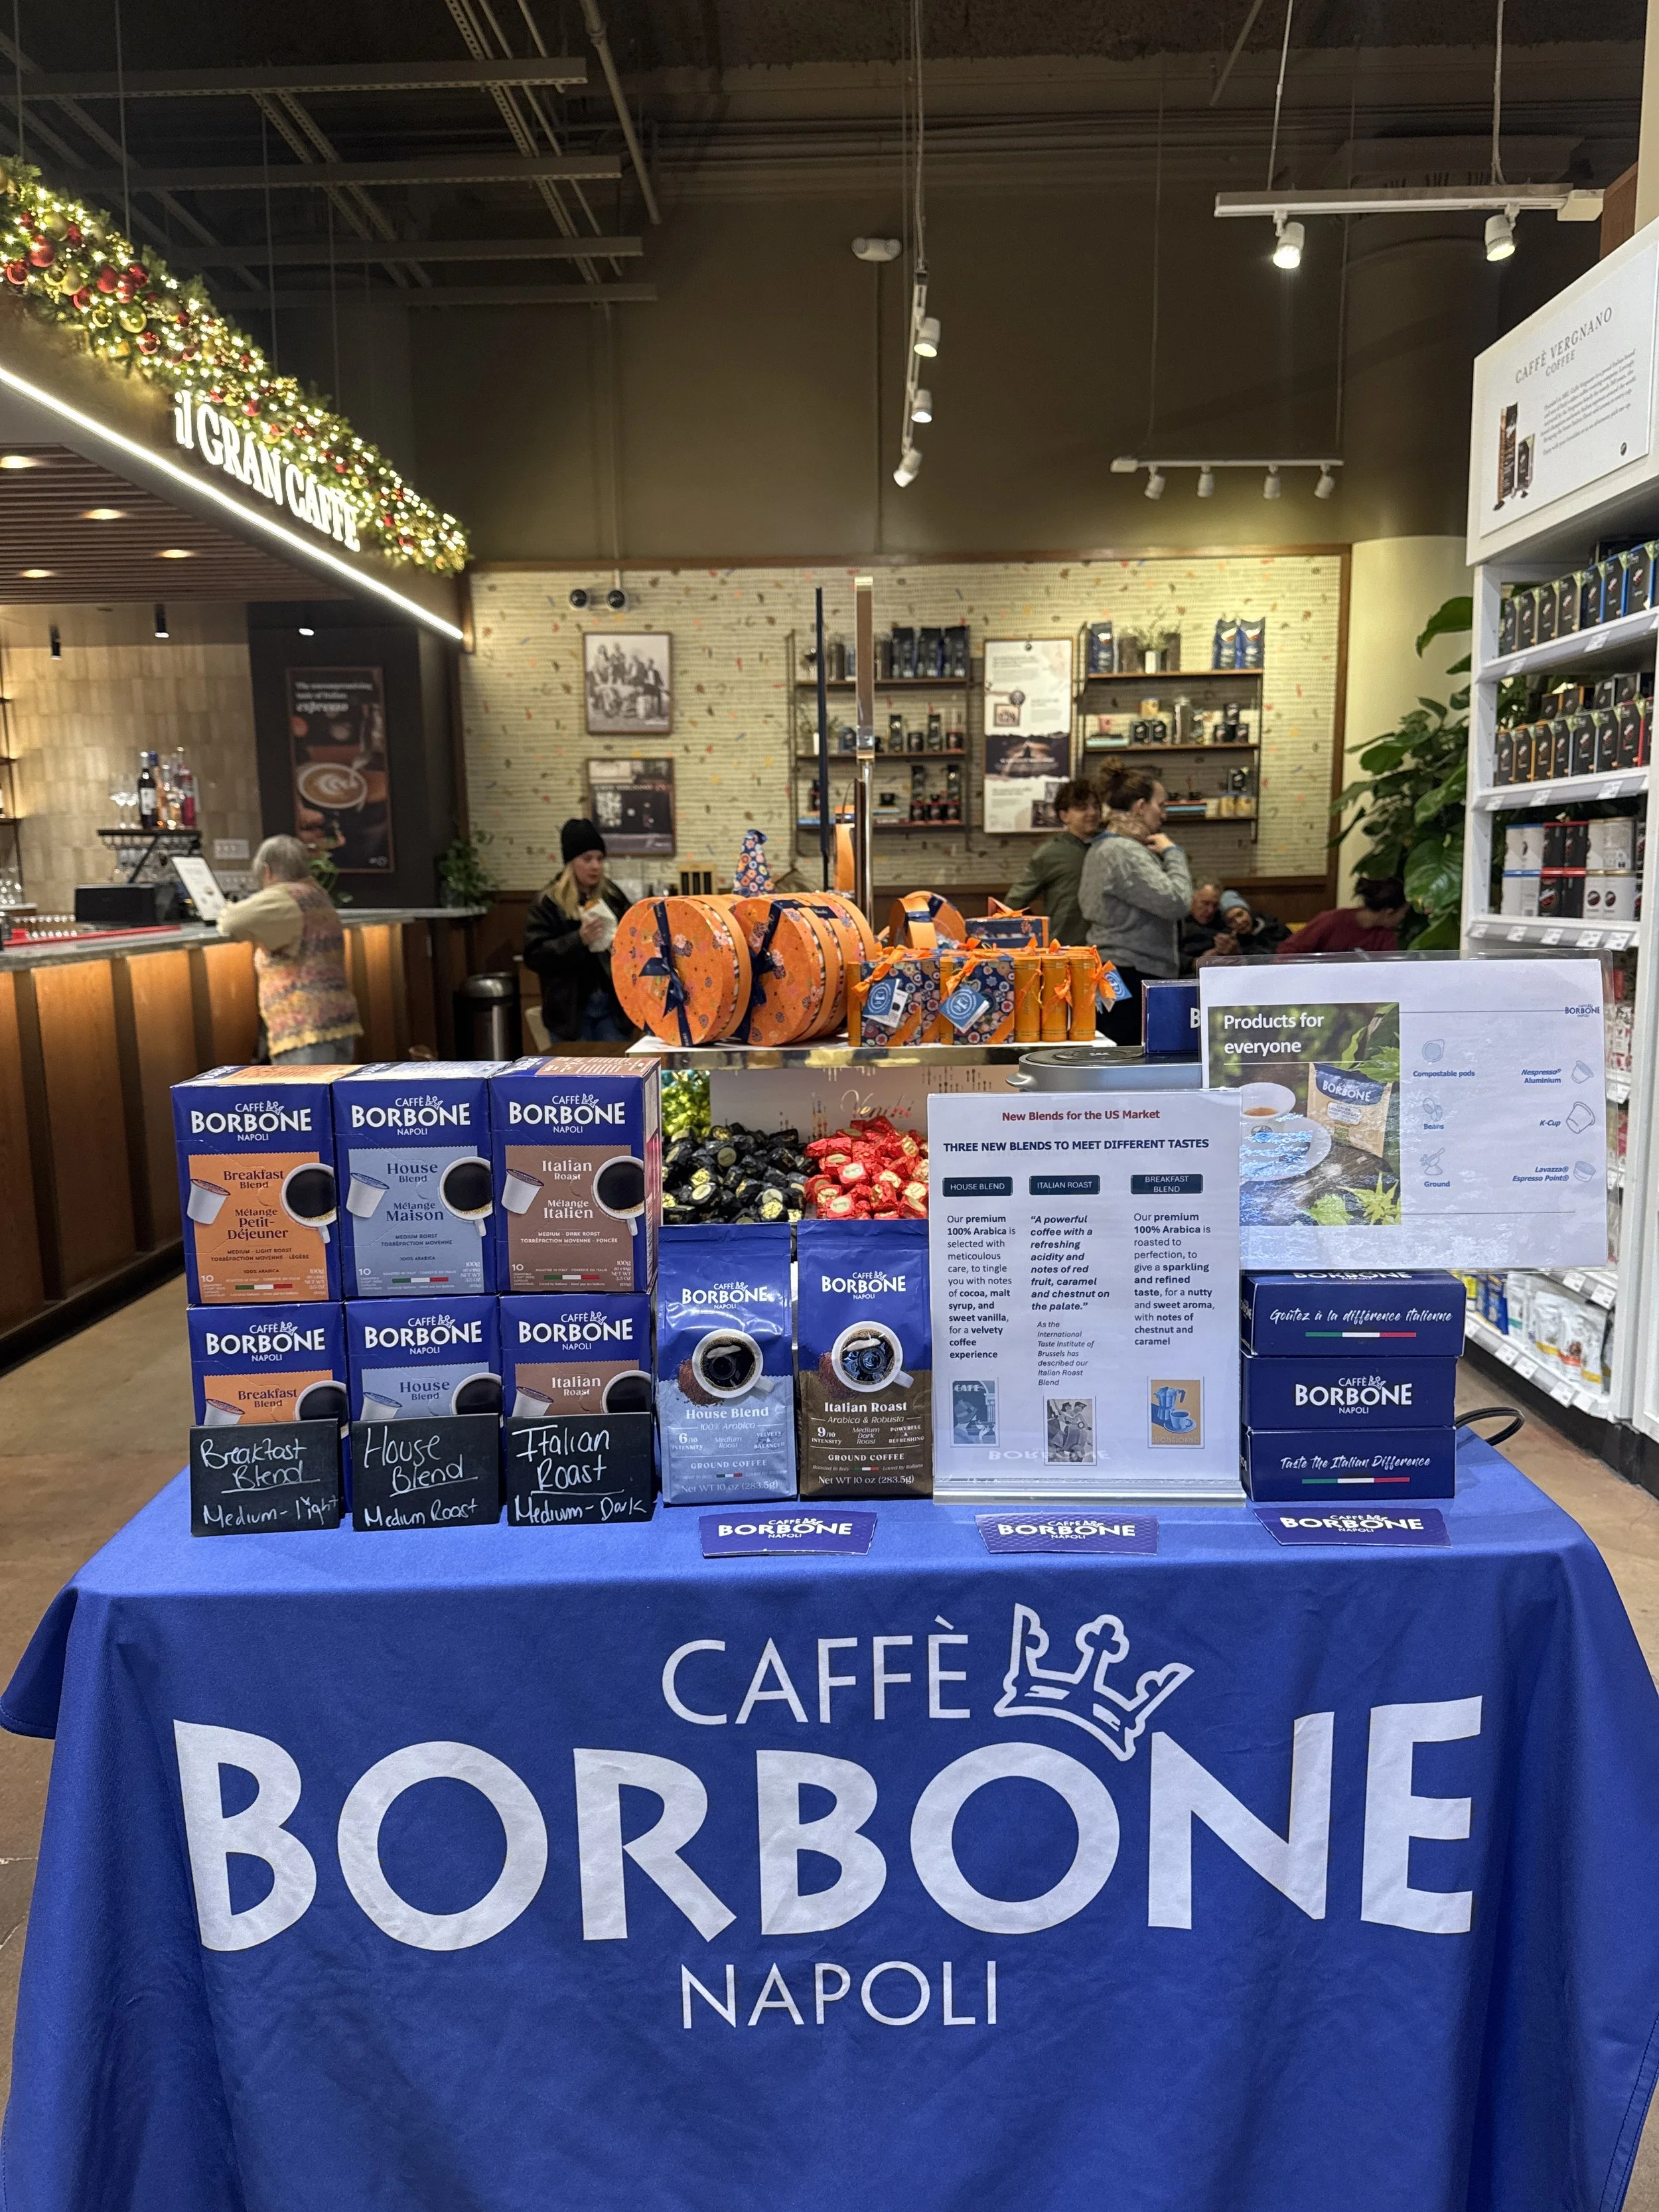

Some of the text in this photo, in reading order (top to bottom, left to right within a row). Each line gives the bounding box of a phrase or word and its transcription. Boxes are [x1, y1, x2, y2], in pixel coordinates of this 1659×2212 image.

[1551, 307, 1612, 359] VERGNANO
[1546, 349, 1575, 377] COFFEE
[175, 390, 194, 449] il
[197, 404, 283, 505] GRAN
[1224, 1012, 1324, 1029] Products for
[1224, 1041, 1301, 1056] everyone
[396, 1096, 423, 1107] CAFFÈ
[552, 1094, 580, 1104] CAFFÈ
[235, 1101, 264, 1112] CAFFÈ
[509, 1101, 625, 1124] BORBONE
[190, 1108, 312, 1133] BORBONE
[352, 1103, 470, 1128] BORBONE
[1002, 1110, 1160, 1121] New Blends for the US Market
[943, 1139, 1209, 1152] THREE NEW BLENDS TO MEET DIFFERENT TASTES
[388, 1163, 438, 1174] House
[542, 1160, 592, 1171] Italian
[224, 1169, 284, 1180] Breakfast
[548, 1199, 589, 1208] Mélange
[386, 1210, 444, 1222] Maison
[544, 1207, 593, 1218] Italien
[239, 1217, 275, 1228] Petit-
[966, 1215, 1006, 1224] premium
[228, 1229, 288, 1241] Déjeuner
[948, 1252, 1001, 1260] meticoulous
[982, 1264, 1007, 1274] tingle
[822, 1276, 906, 1293] BORBONE
[966, 1276, 985, 1285] with
[682, 1286, 768, 1305] BORBONE
[948, 1289, 958, 1297] of
[978, 1301, 994, 1309] and
[977, 1313, 1009, 1322] vanilla,
[1315, 1309, 1322, 1321] à
[1327, 1309, 1338, 1321] la
[1342, 1308, 1401, 1325] différence
[1405, 1307, 1453, 1322] italienne
[365, 1321, 482, 1349] BORBONE
[519, 1318, 633, 1343] BORBONE
[971, 1325, 1003, 1335] velvety
[206, 1328, 325, 1355] BORBONE
[950, 1351, 998, 1360] experience
[400, 1381, 450, 1392] House
[552, 1376, 601, 1388] Italian
[1338, 1376, 1366, 1386] CAFFÈ
[238, 1388, 297, 1400] Breakfast
[1295, 1383, 1412, 1406] BORBONE
[685, 1407, 769, 1420] House Blend
[824, 1402, 907, 1412] Italian Roast
[364, 1426, 441, 1468] House
[512, 1425, 609, 1462] Italian
[200, 1438, 307, 1469] Breakfast
[1280, 1456, 1307, 1470] Taste
[1330, 1455, 1368, 1469] Italian
[1372, 1455, 1431, 1471] Difference
[233, 1460, 303, 1489] Blend
[392, 1453, 463, 1493] Blend
[537, 1454, 607, 1491] Roast
[431, 1498, 478, 1521] Roast
[601, 1497, 647, 1521] Dark
[718, 1522, 853, 1537] BORBONE
[998, 1524, 1135, 1536] BORBONE
[1280, 1517, 1423, 1530] BORBONE
[663, 1615, 971, 1726] CAFFÈ
[173, 1696, 1482, 1952] BORBONE
[680, 1960, 996, 2029] NAPOLI
